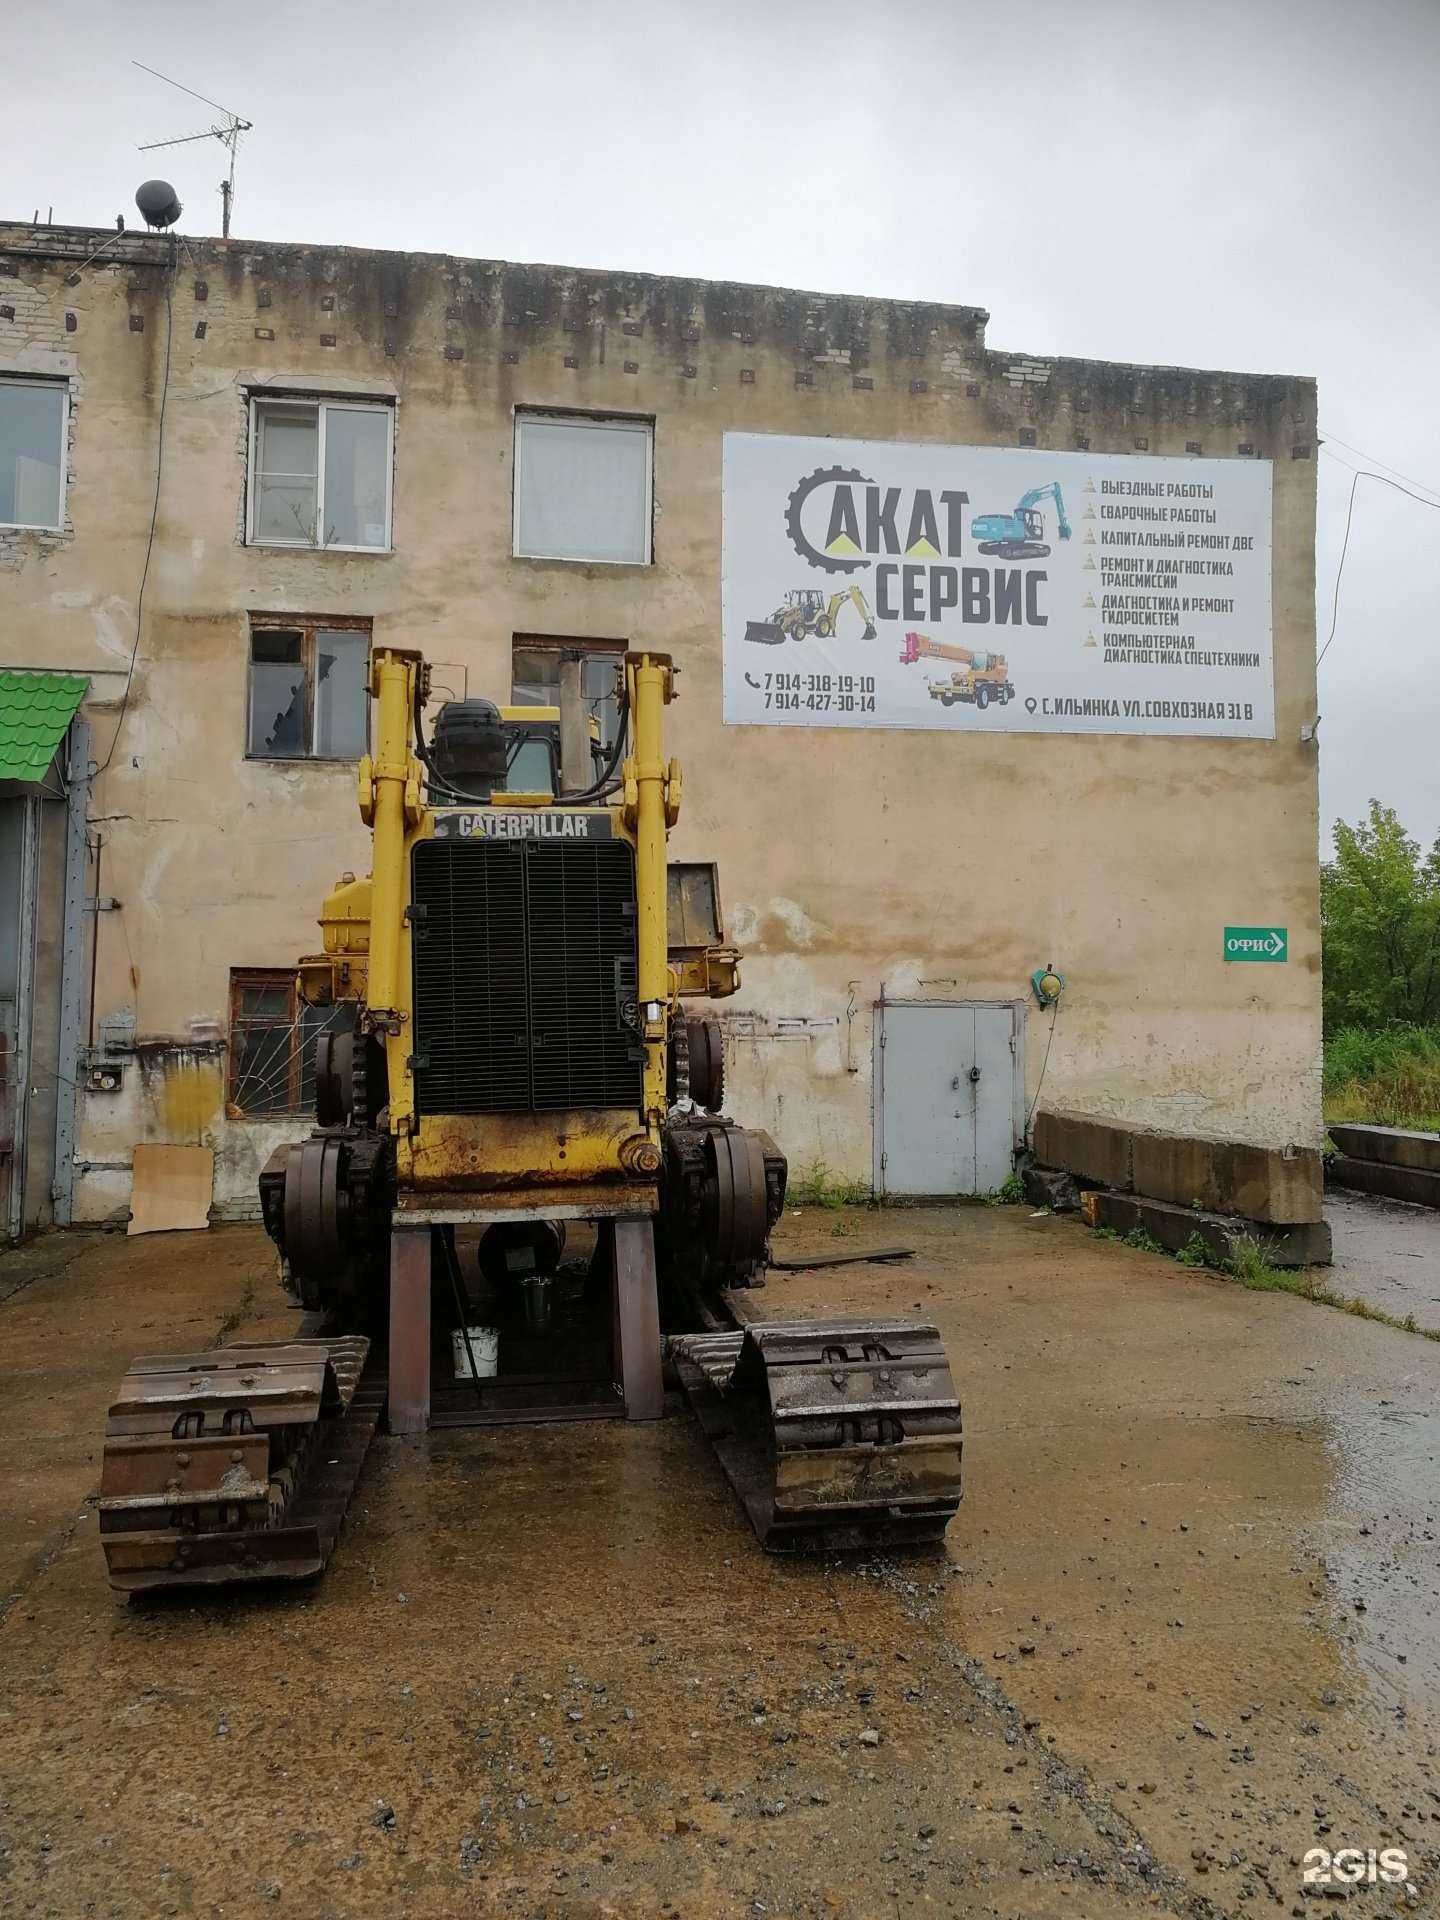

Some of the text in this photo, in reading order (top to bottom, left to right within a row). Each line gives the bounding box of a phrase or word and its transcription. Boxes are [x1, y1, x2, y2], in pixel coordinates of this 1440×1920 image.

[1101, 480, 1213, 499] ВЫЕЗДНЫЕ РАБОТЫ
[825, 485, 969, 558] АКАТ
[1101, 505, 1216, 523] СВАРОЧНЫЕ РАБОТЫ
[1101, 530, 1254, 551] КАПИТАЛЬНЫЙ РЕМОНТ ДВС
[1101, 557, 1234, 576] РЕМОНТ И ДИАГНОСТИКА
[1101, 573, 1178, 589] ТРАНСМИССИИ
[876, 563, 1048, 626] СЕРВИС
[1101, 595, 1234, 613] ДИАГНОСТИКА И РЕМОНТ
[1101, 610, 1179, 626] ГИДРОСИСТЕМ
[1103, 633, 1195, 649] КОМПЬЮТЕРНАЯ
[1103, 649, 1260, 667] ДИАГНОСТИКА СПЕЦТЕХНИКИ
[764, 673, 875, 693] 7 914-318-19-10
[764, 693, 876, 712] 7 914-427-30-14
[1042, 698, 1120, 717] С.ИЛЬИНКА
[1122, 700, 1225, 720] УЛ.СОВХОЗНАЯ
[459, 814, 588, 837] CATERPILLAR
[1227, 938, 1274, 952] ОФИС
